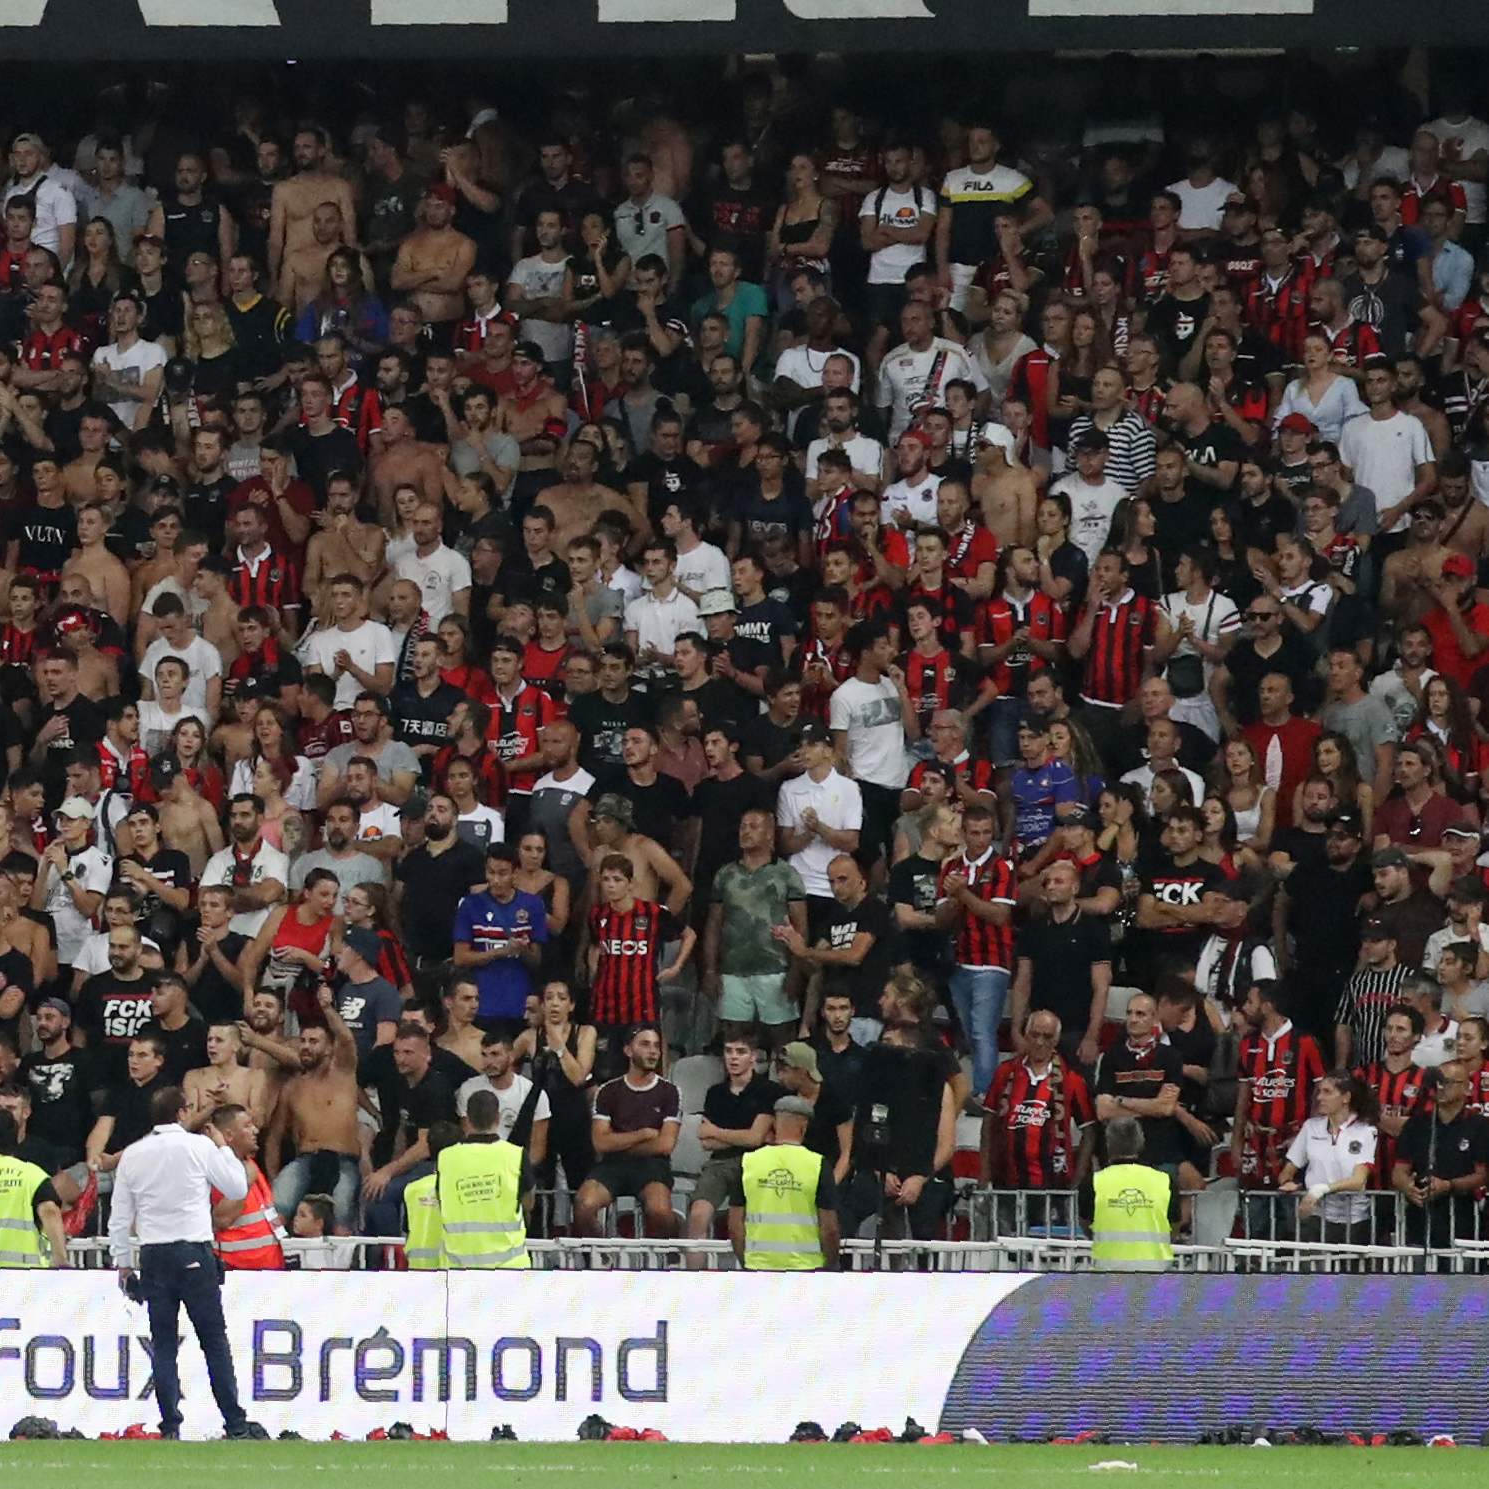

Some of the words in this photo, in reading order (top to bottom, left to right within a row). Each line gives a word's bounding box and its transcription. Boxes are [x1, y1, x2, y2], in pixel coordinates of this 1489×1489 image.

[963, 181, 994, 192] FILA
[24, 524, 66, 545] VLTN
[599, 939, 648, 956] NEOS
[103, 999, 152, 1018] FCK
[249, 1318, 668, 1402] Brémond
